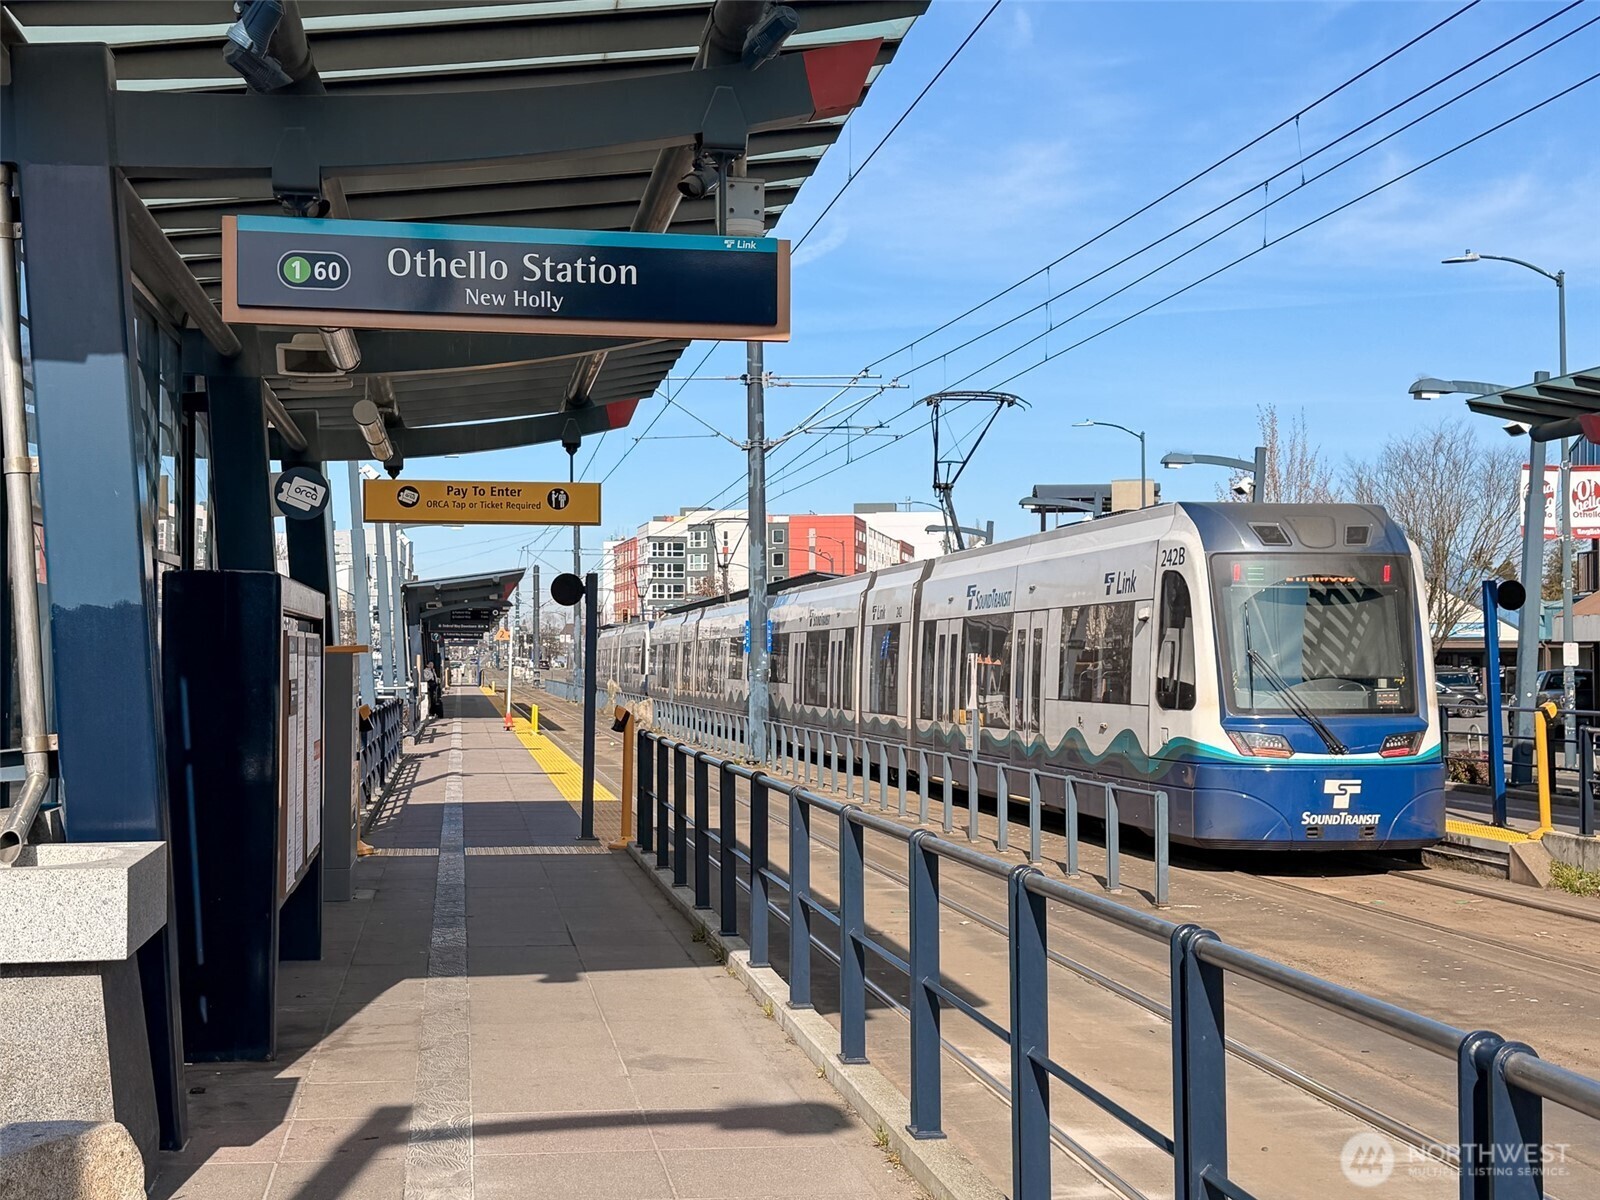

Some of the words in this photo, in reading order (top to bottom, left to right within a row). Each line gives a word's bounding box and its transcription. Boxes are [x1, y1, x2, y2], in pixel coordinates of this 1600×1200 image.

[737, 240, 757, 249] Link
[291, 260, 301, 280] 1
[314, 261, 341, 281] 60
[387, 247, 509, 281] Othello
[522, 253, 638, 285] Station
[465, 288, 507, 307] New
[513, 290, 564, 313] Holly
[294, 487, 318, 501] orca
[447, 485, 468, 499] Pay
[472, 486, 486, 498] To
[490, 486, 522, 499] Enter
[426, 500, 450, 509] ORCA
[452, 501, 466, 511] Tap
[480, 502, 503, 510] Ticket
[506, 502, 542, 511] Required
[1161, 547, 1186, 568] 242B
[1116, 569, 1138, 595] Link
[1301, 811, 1381, 825] SOUNDTRANSIT
